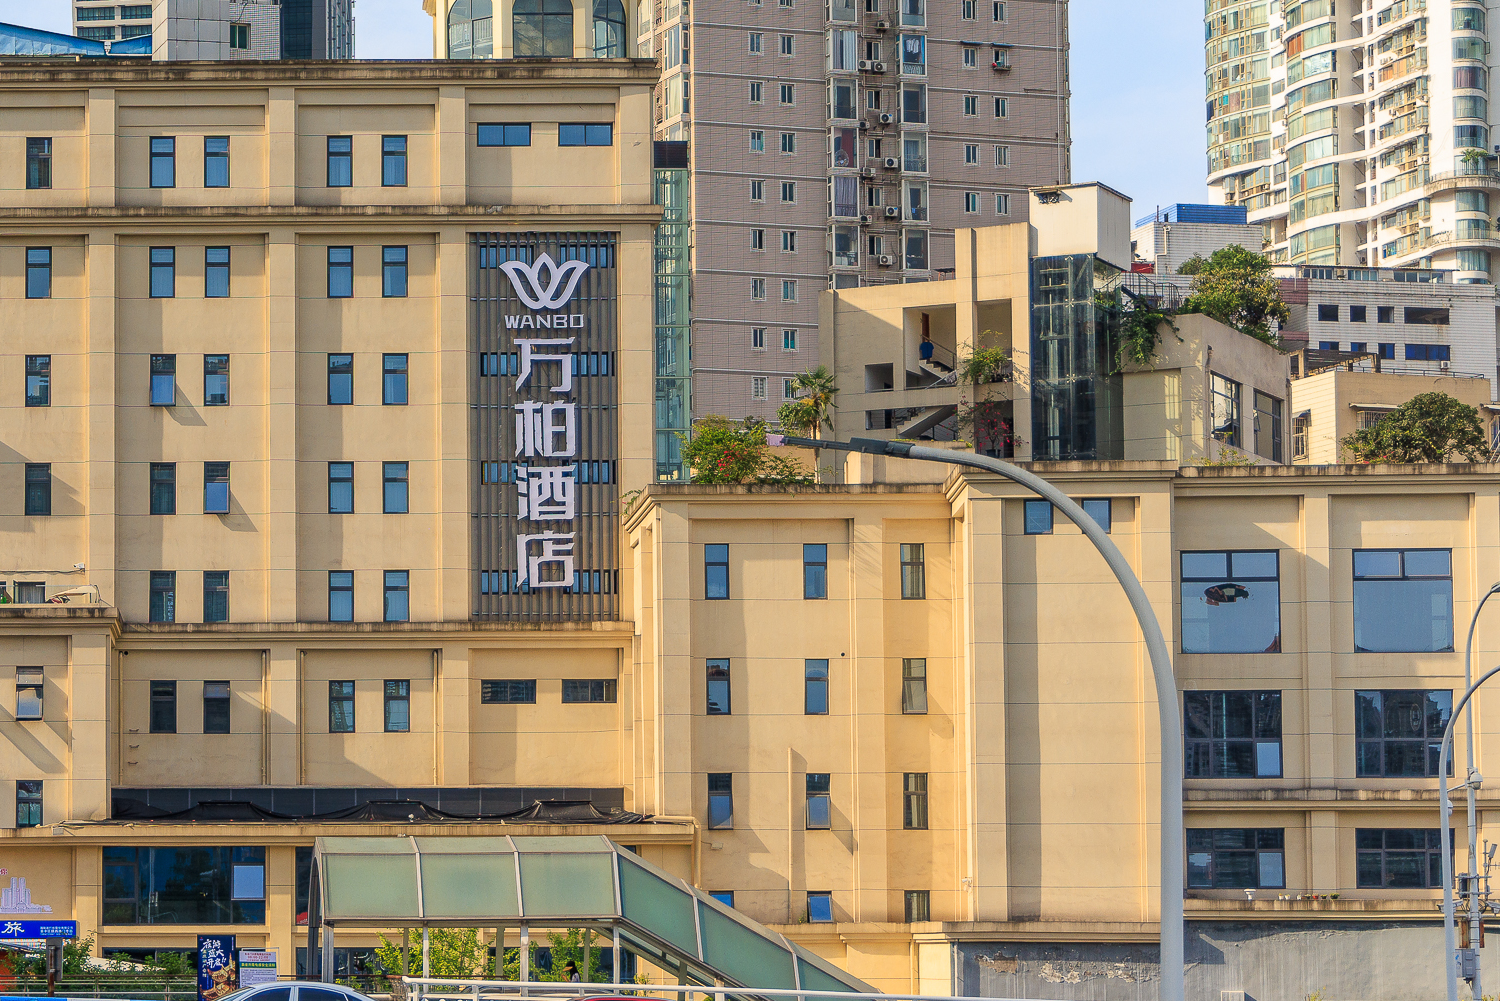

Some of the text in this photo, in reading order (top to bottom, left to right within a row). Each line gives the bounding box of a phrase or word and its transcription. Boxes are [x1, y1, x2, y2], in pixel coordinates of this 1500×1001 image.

[504, 314, 585, 329] WANBO
[513, 336, 577, 589] 万柏酒店
